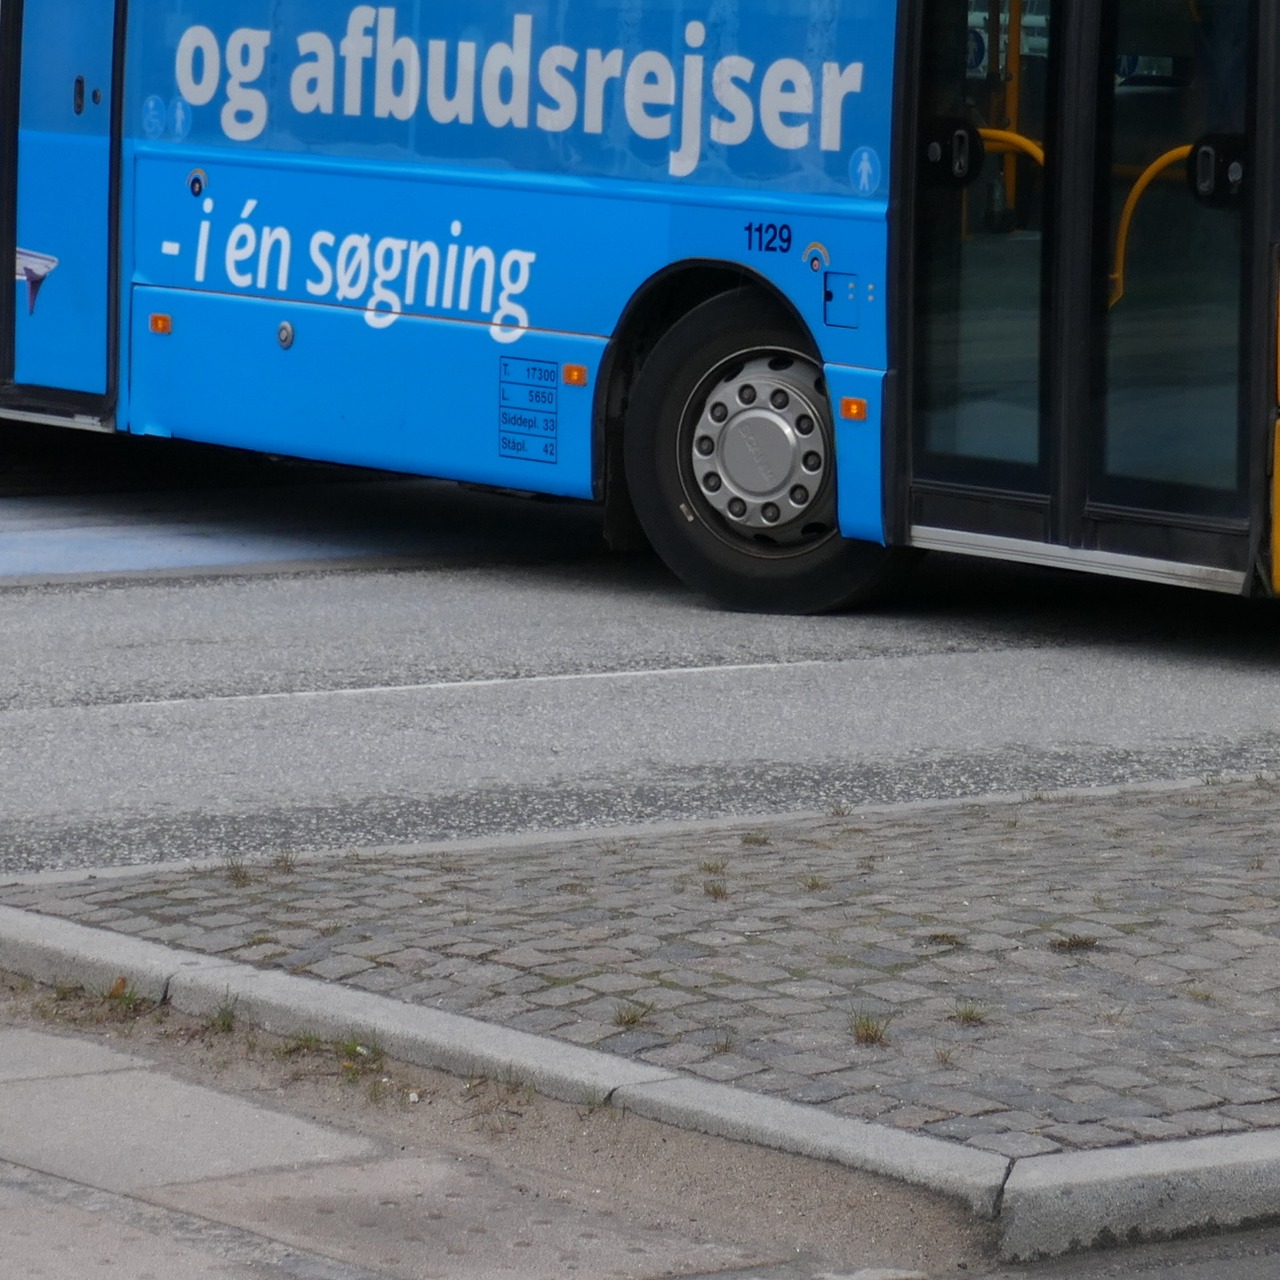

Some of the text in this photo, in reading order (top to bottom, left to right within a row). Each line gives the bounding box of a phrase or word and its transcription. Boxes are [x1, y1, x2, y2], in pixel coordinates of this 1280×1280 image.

[175, 5, 864, 178] og afbudsrejser
[744, 222, 792, 253] 1129
[194, 198, 214, 282] i
[224, 199, 292, 293] én
[306, 221, 536, 344] søgning
[526, 367, 556, 382] 17300
[528, 390, 554, 404] 5650
[501, 412, 555, 431] Siddepl. 33
[543, 443, 555, 456] 42
